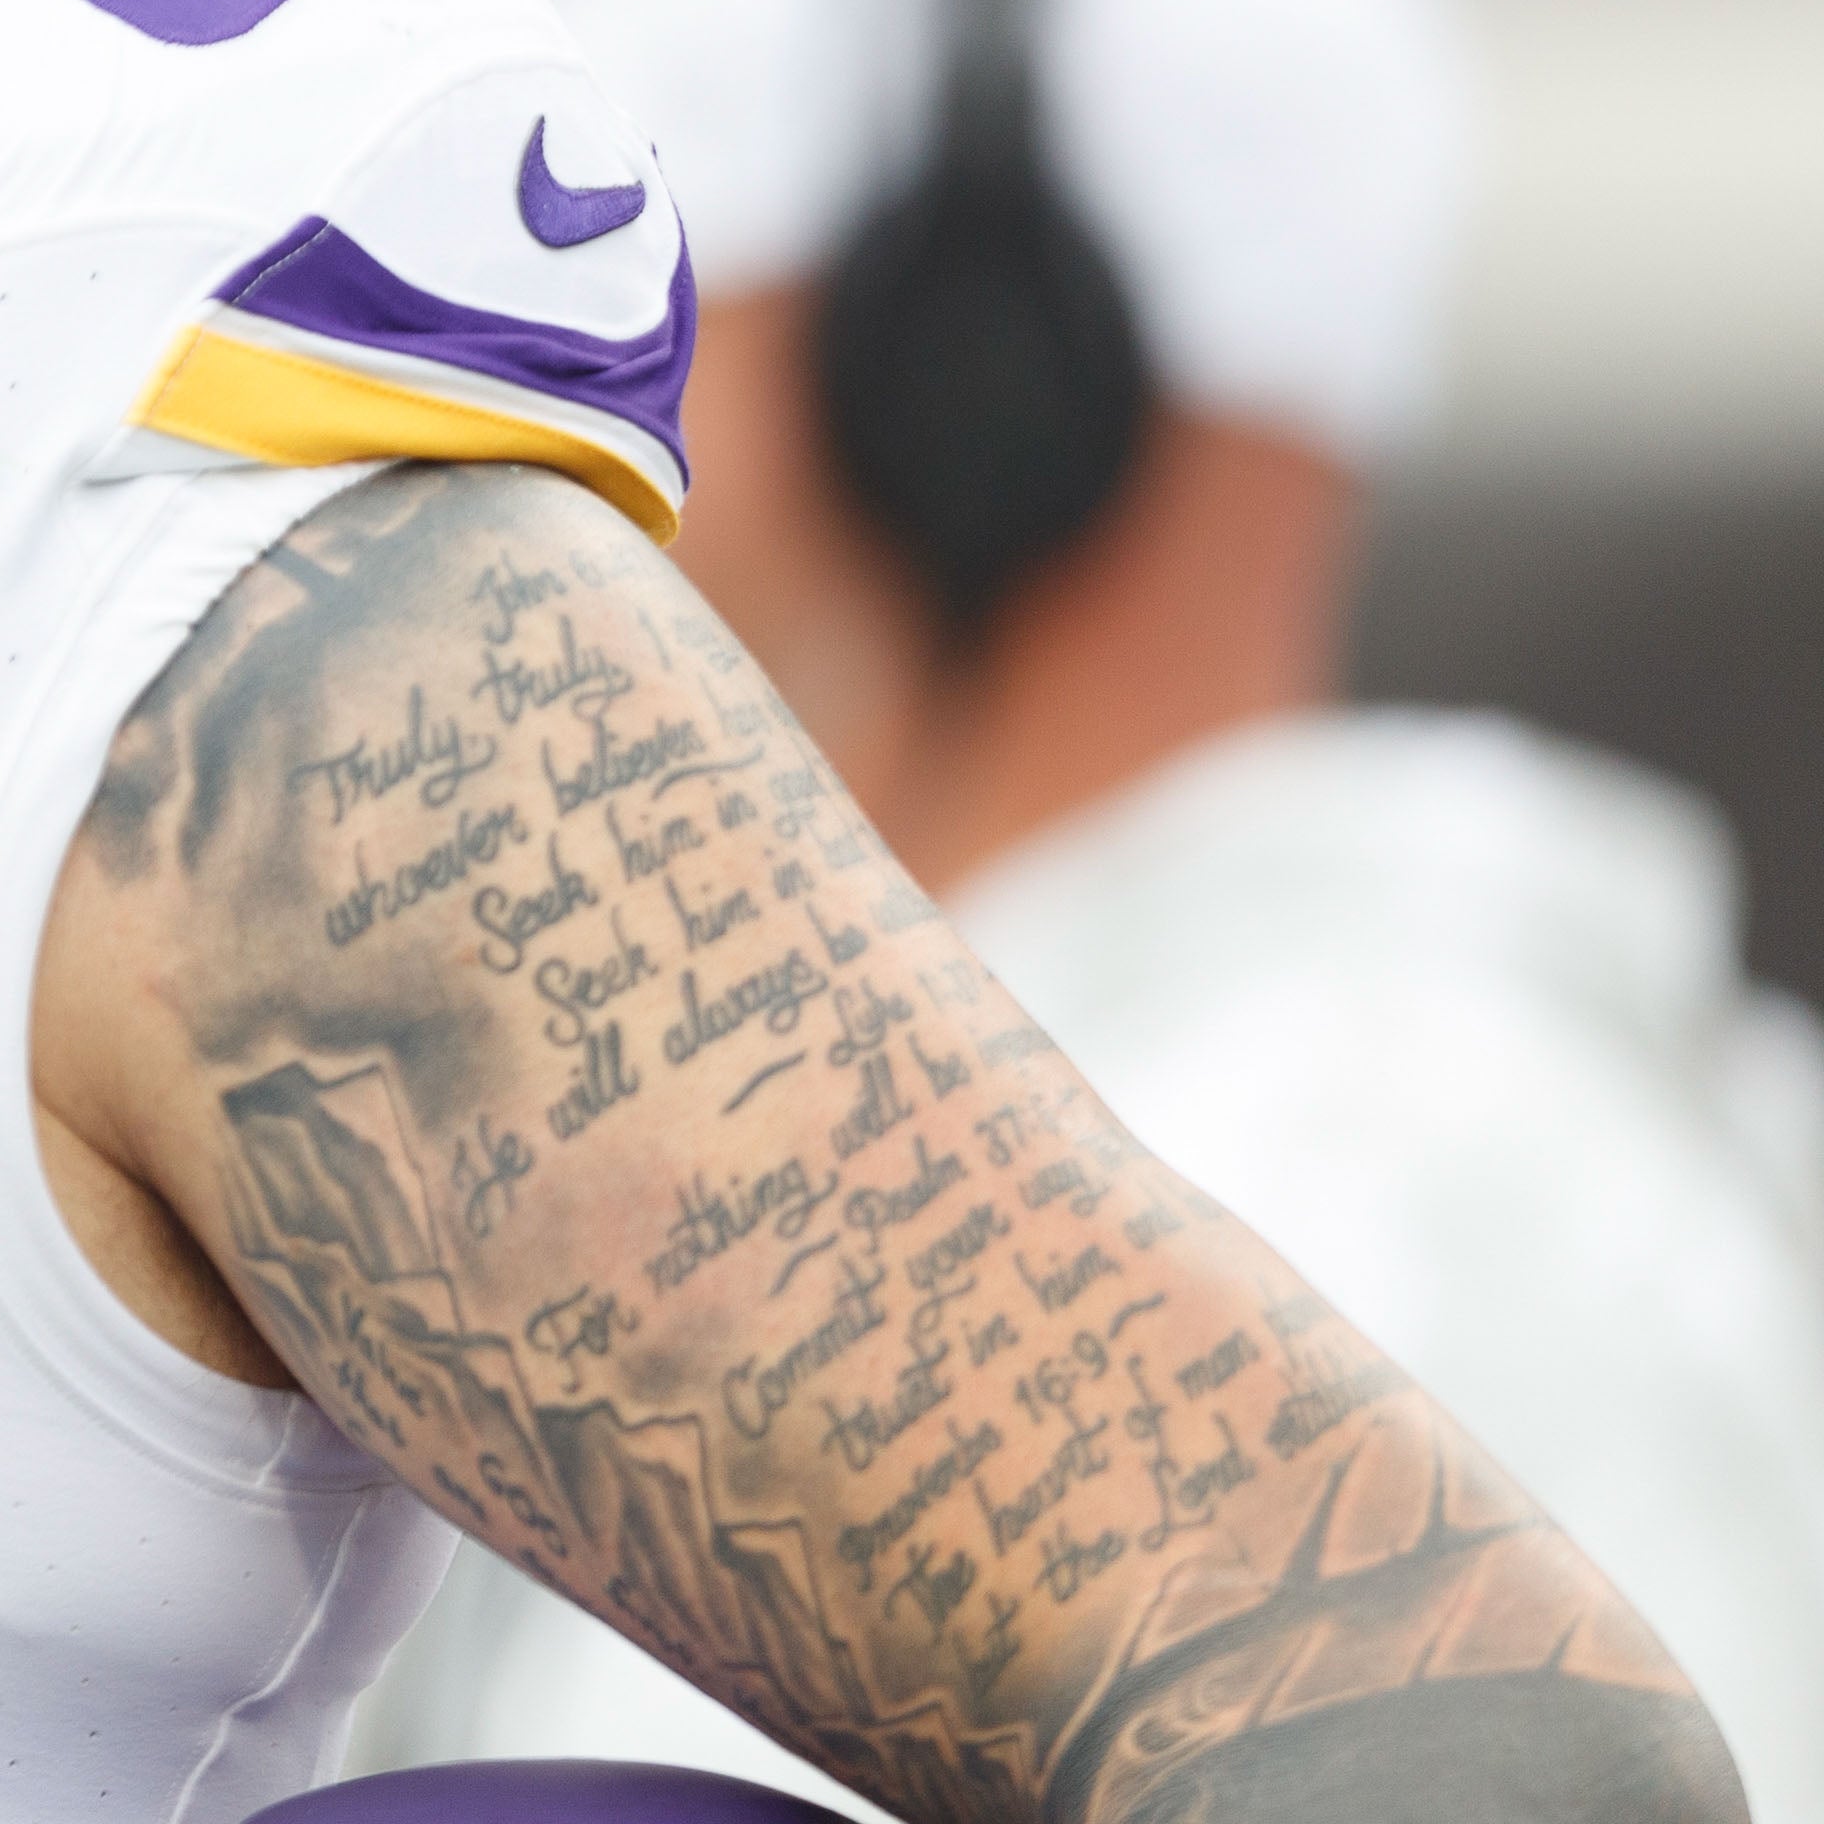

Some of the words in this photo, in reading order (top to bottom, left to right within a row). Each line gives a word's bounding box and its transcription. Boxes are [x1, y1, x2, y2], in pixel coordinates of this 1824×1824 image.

[606, 798, 709, 884] him
[664, 874, 762, 955] him
[547, 1020, 641, 1144] will
[644, 1154, 840, 1298] nothing
[958, 1312, 1021, 1369] in
